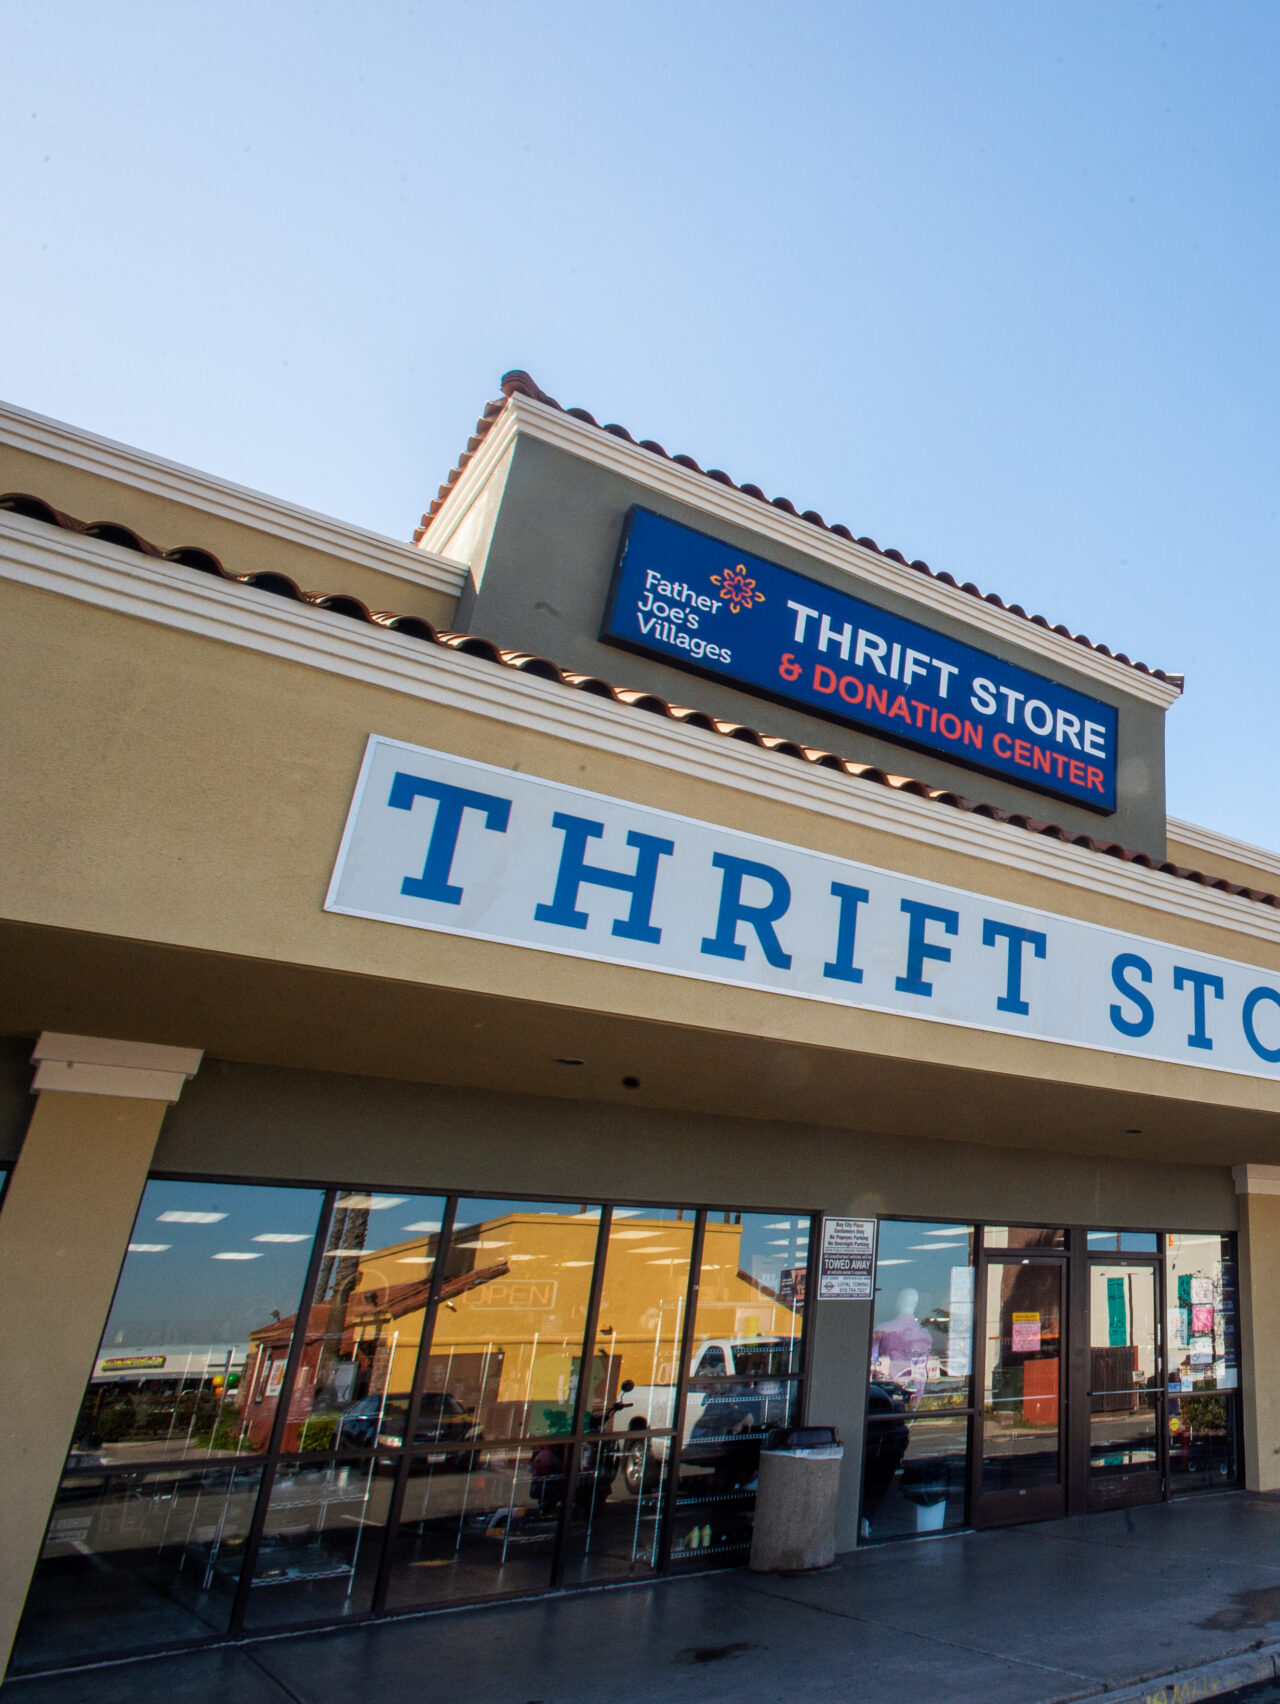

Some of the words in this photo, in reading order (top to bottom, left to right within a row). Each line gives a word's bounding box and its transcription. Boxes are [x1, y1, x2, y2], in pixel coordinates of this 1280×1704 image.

[637, 591, 699, 629] Joe's
[646, 569, 722, 614] Father
[637, 612, 732, 664] Villages
[787, 600, 958, 698] THRIFT
[970, 677, 1106, 759] STORE
[779, 653, 802, 681] &
[813, 665, 983, 750] DONATION
[993, 733, 1104, 794] CENTER
[387, 771, 1046, 1016] THRIFT
[825, 1259, 850, 1269] TOWED
[851, 1260, 871, 1269] AWAY
